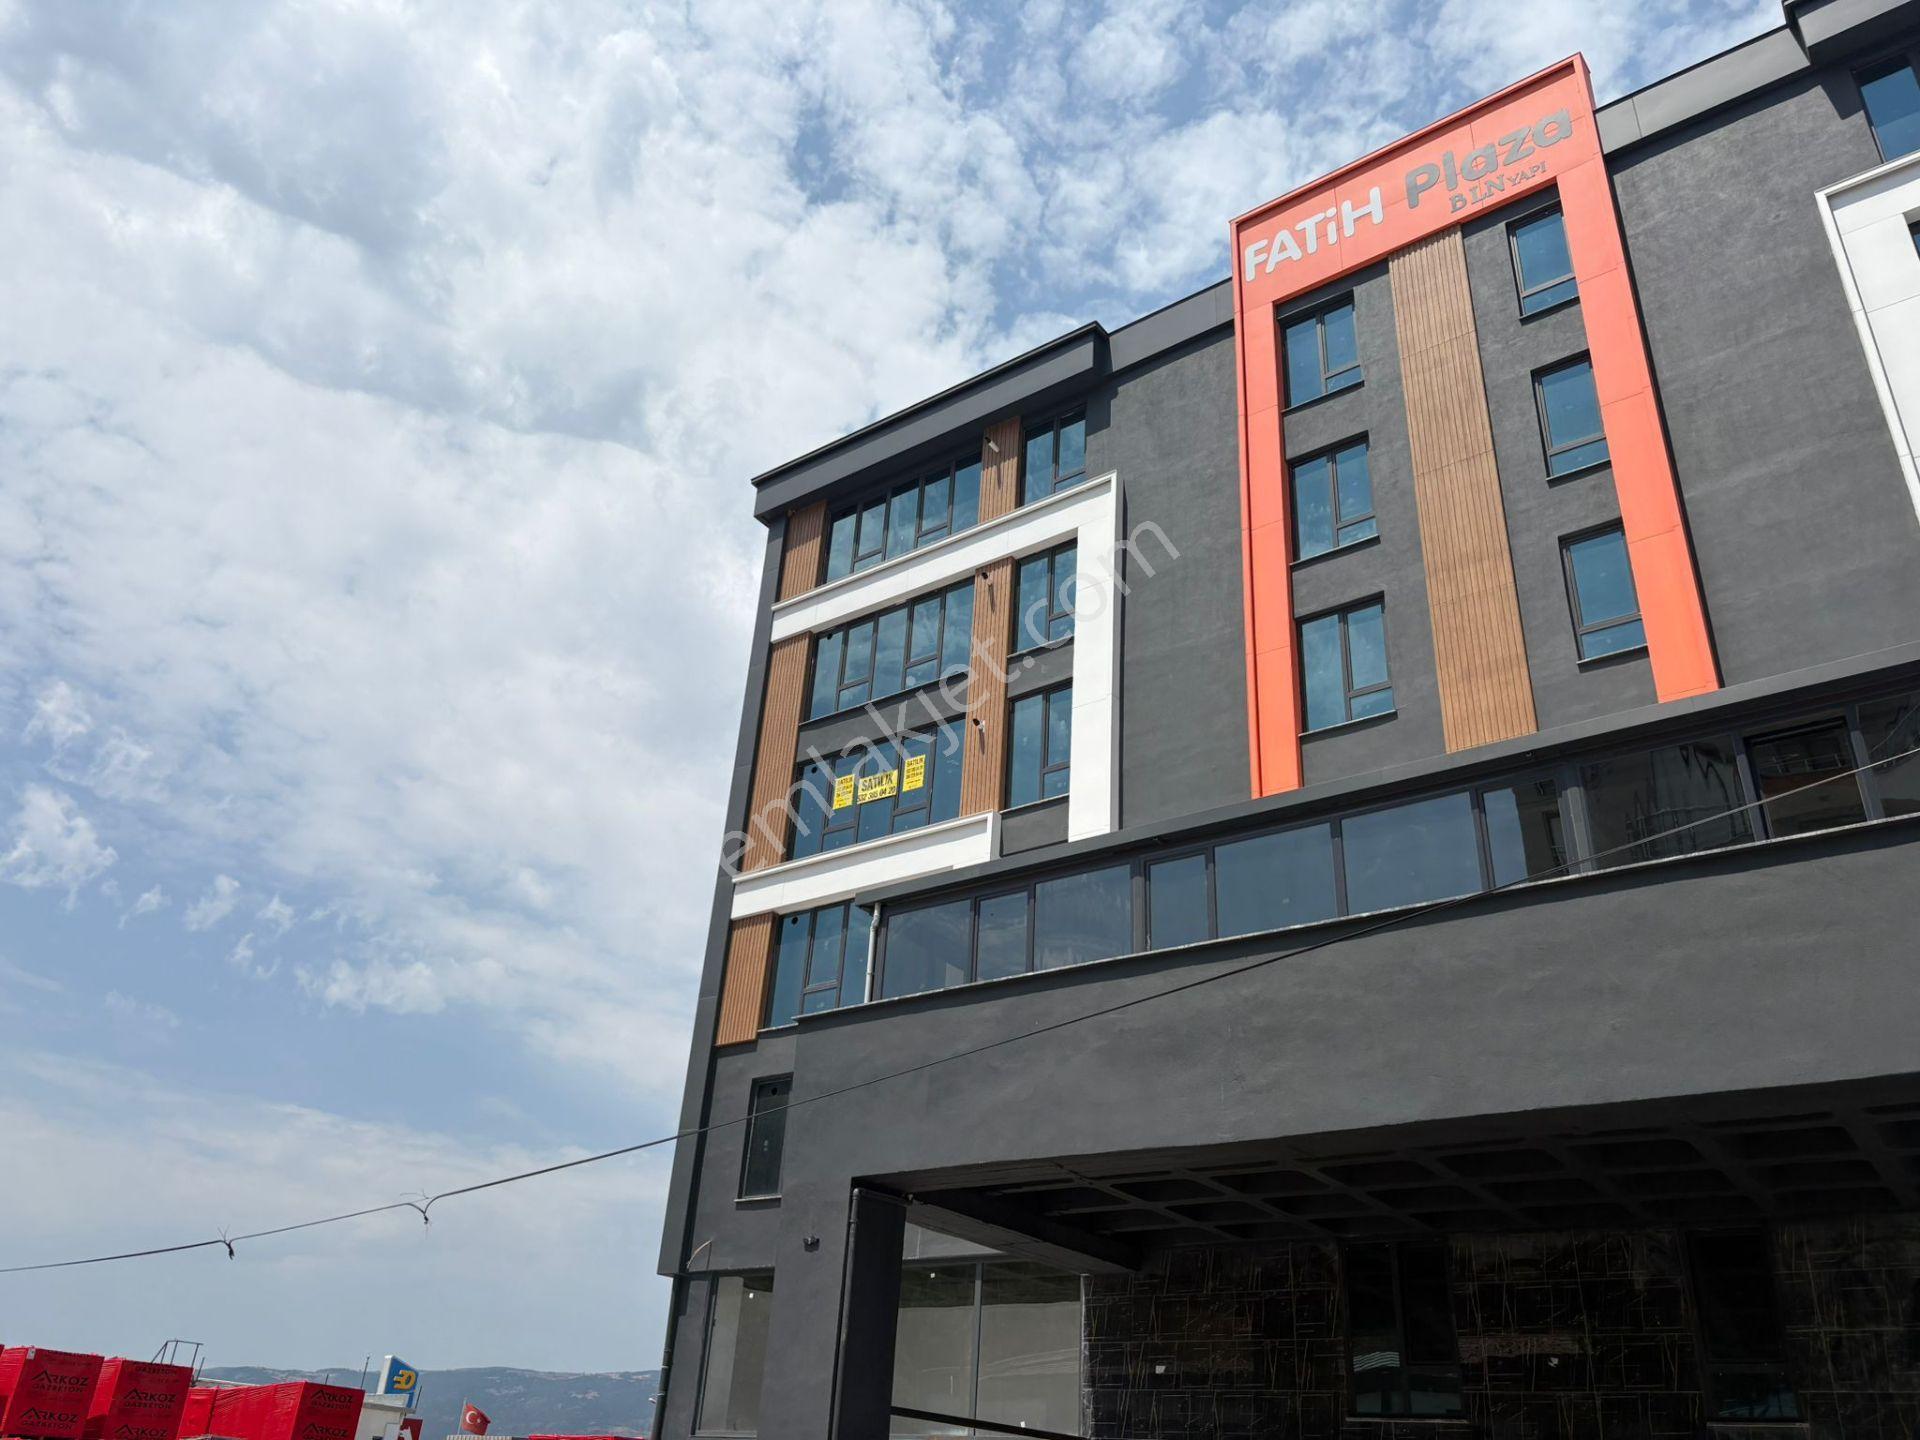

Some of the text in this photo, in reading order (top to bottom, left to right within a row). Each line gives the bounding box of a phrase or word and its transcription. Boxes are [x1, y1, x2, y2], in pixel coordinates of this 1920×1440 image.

[1405, 108, 1574, 209] Plaza
[32, 1369, 90, 1386] ARKOZ
[123, 1388, 177, 1403] ARKOZ
[311, 1389, 353, 1404] ARKOZ
[20, 1407, 79, 1423] ARKOZ
[114, 1424, 168, 1438] ARKOZ
